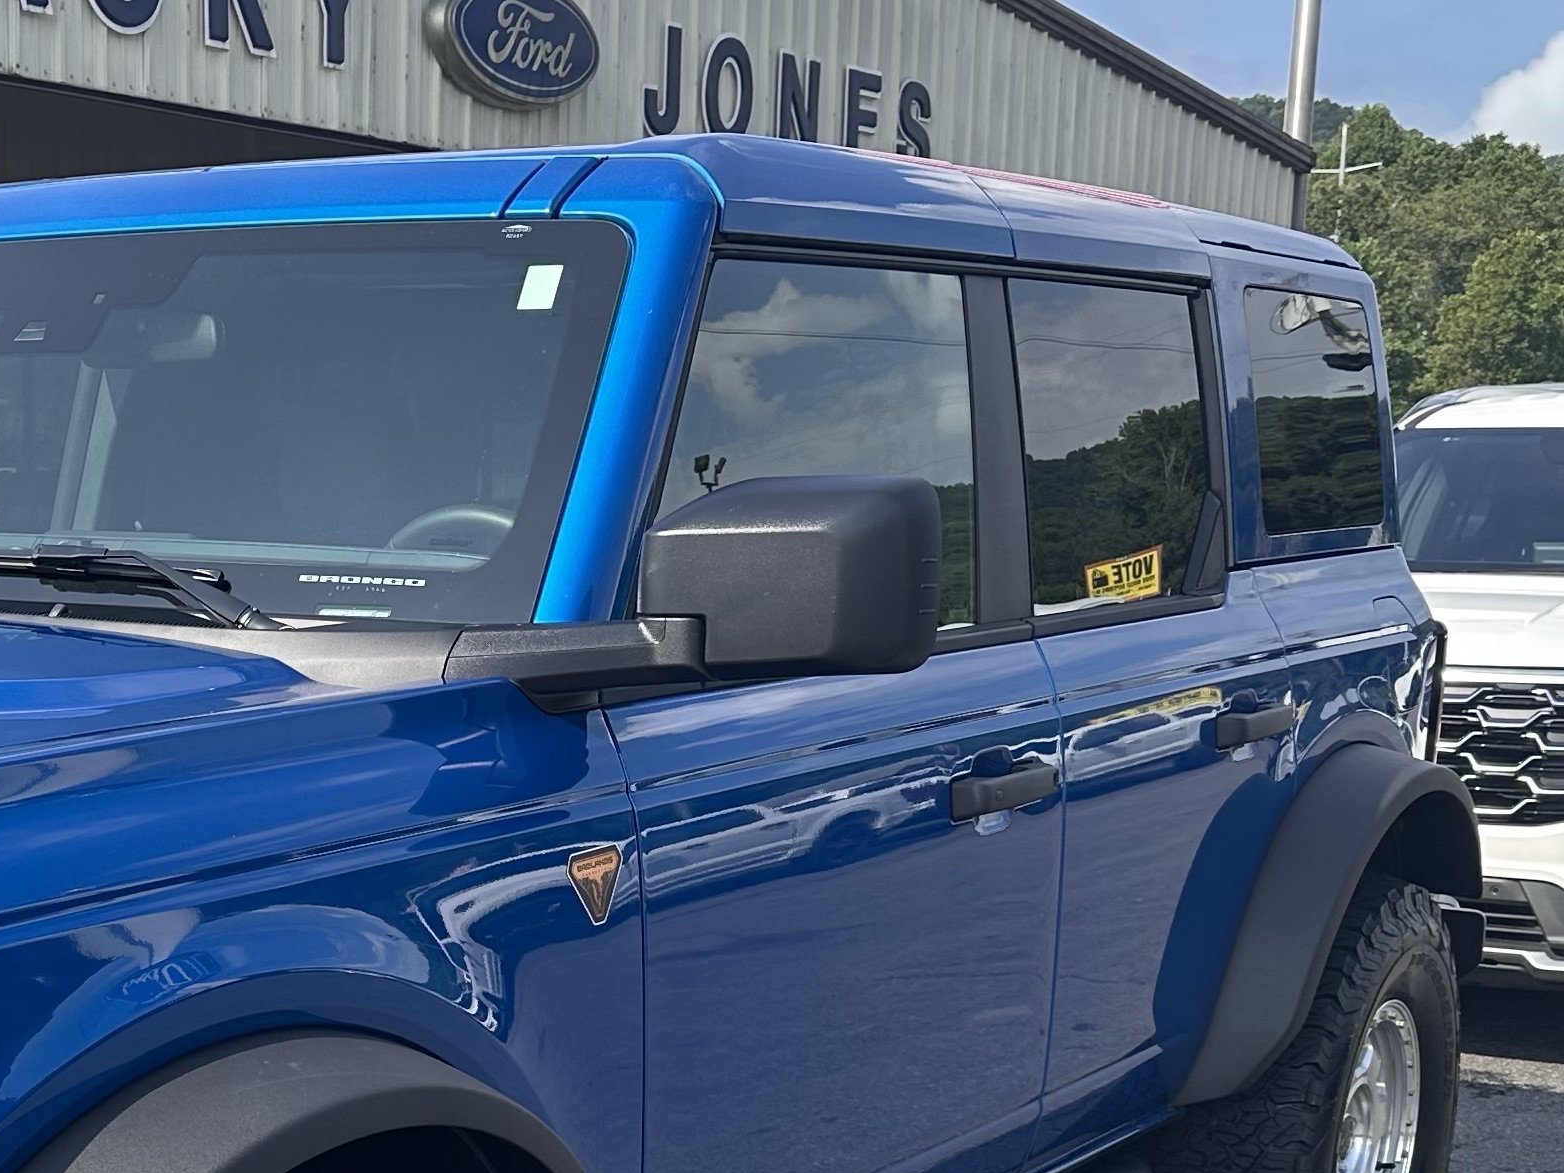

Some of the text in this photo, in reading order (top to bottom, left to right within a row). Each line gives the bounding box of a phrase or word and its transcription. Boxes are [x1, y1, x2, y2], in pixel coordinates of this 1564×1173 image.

[487, 0, 576, 79] Ford
[642, 20, 932, 158] JONES
[298, 574, 426, 587] BRONCO
